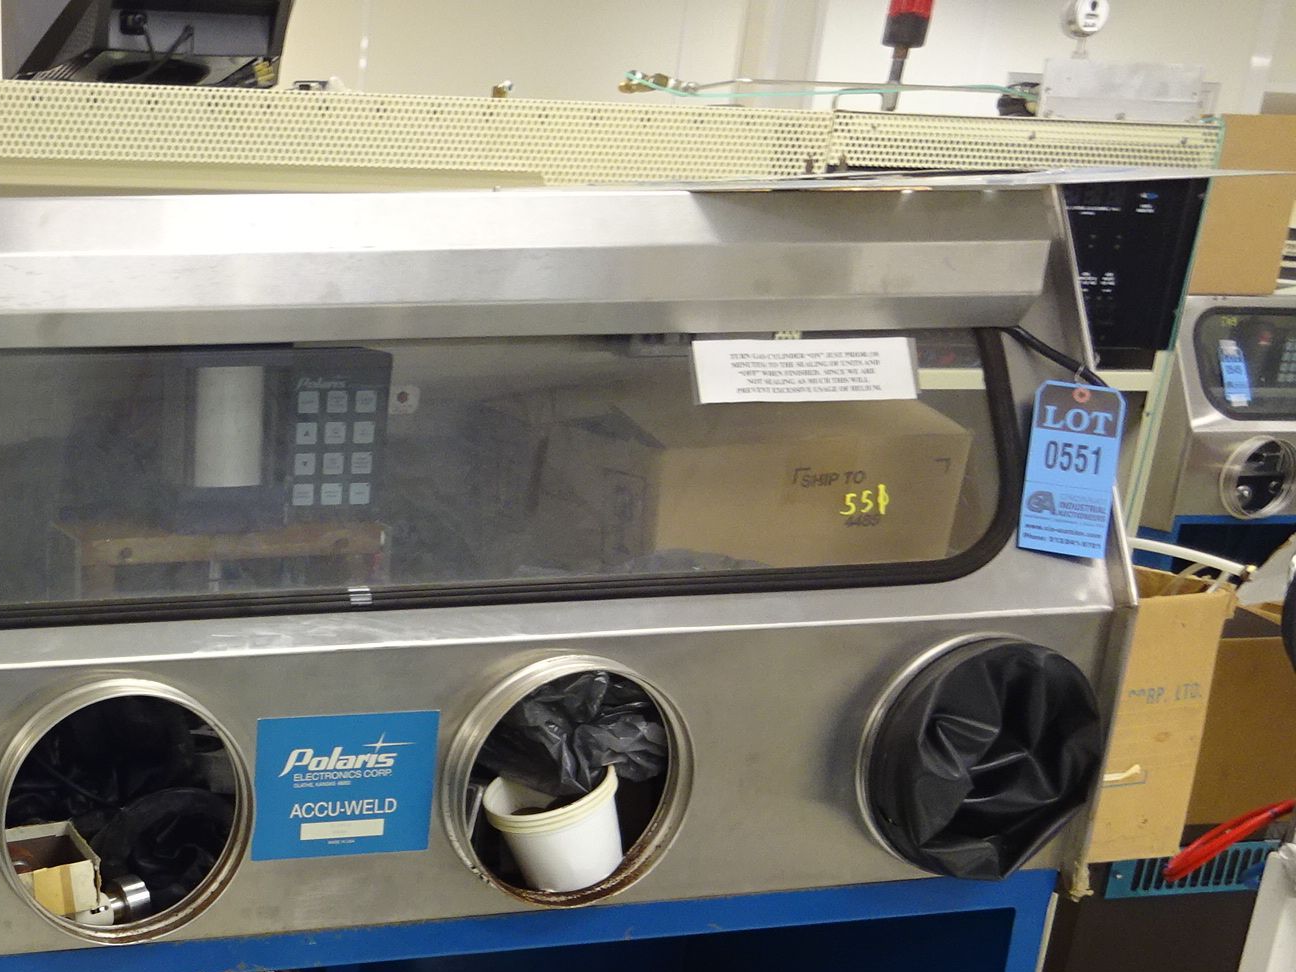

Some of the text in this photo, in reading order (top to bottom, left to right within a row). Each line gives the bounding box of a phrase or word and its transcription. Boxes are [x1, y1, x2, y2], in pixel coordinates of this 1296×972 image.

[1042, 405, 1112, 435] LOT
[1044, 440, 1103, 475] 0551
[801, 470, 865, 488] SHIP TO
[278, 746, 398, 778] Polaris
[293, 768, 393, 782] ELECTRONICS CORP.
[289, 797, 398, 819] ACCU-WELD
